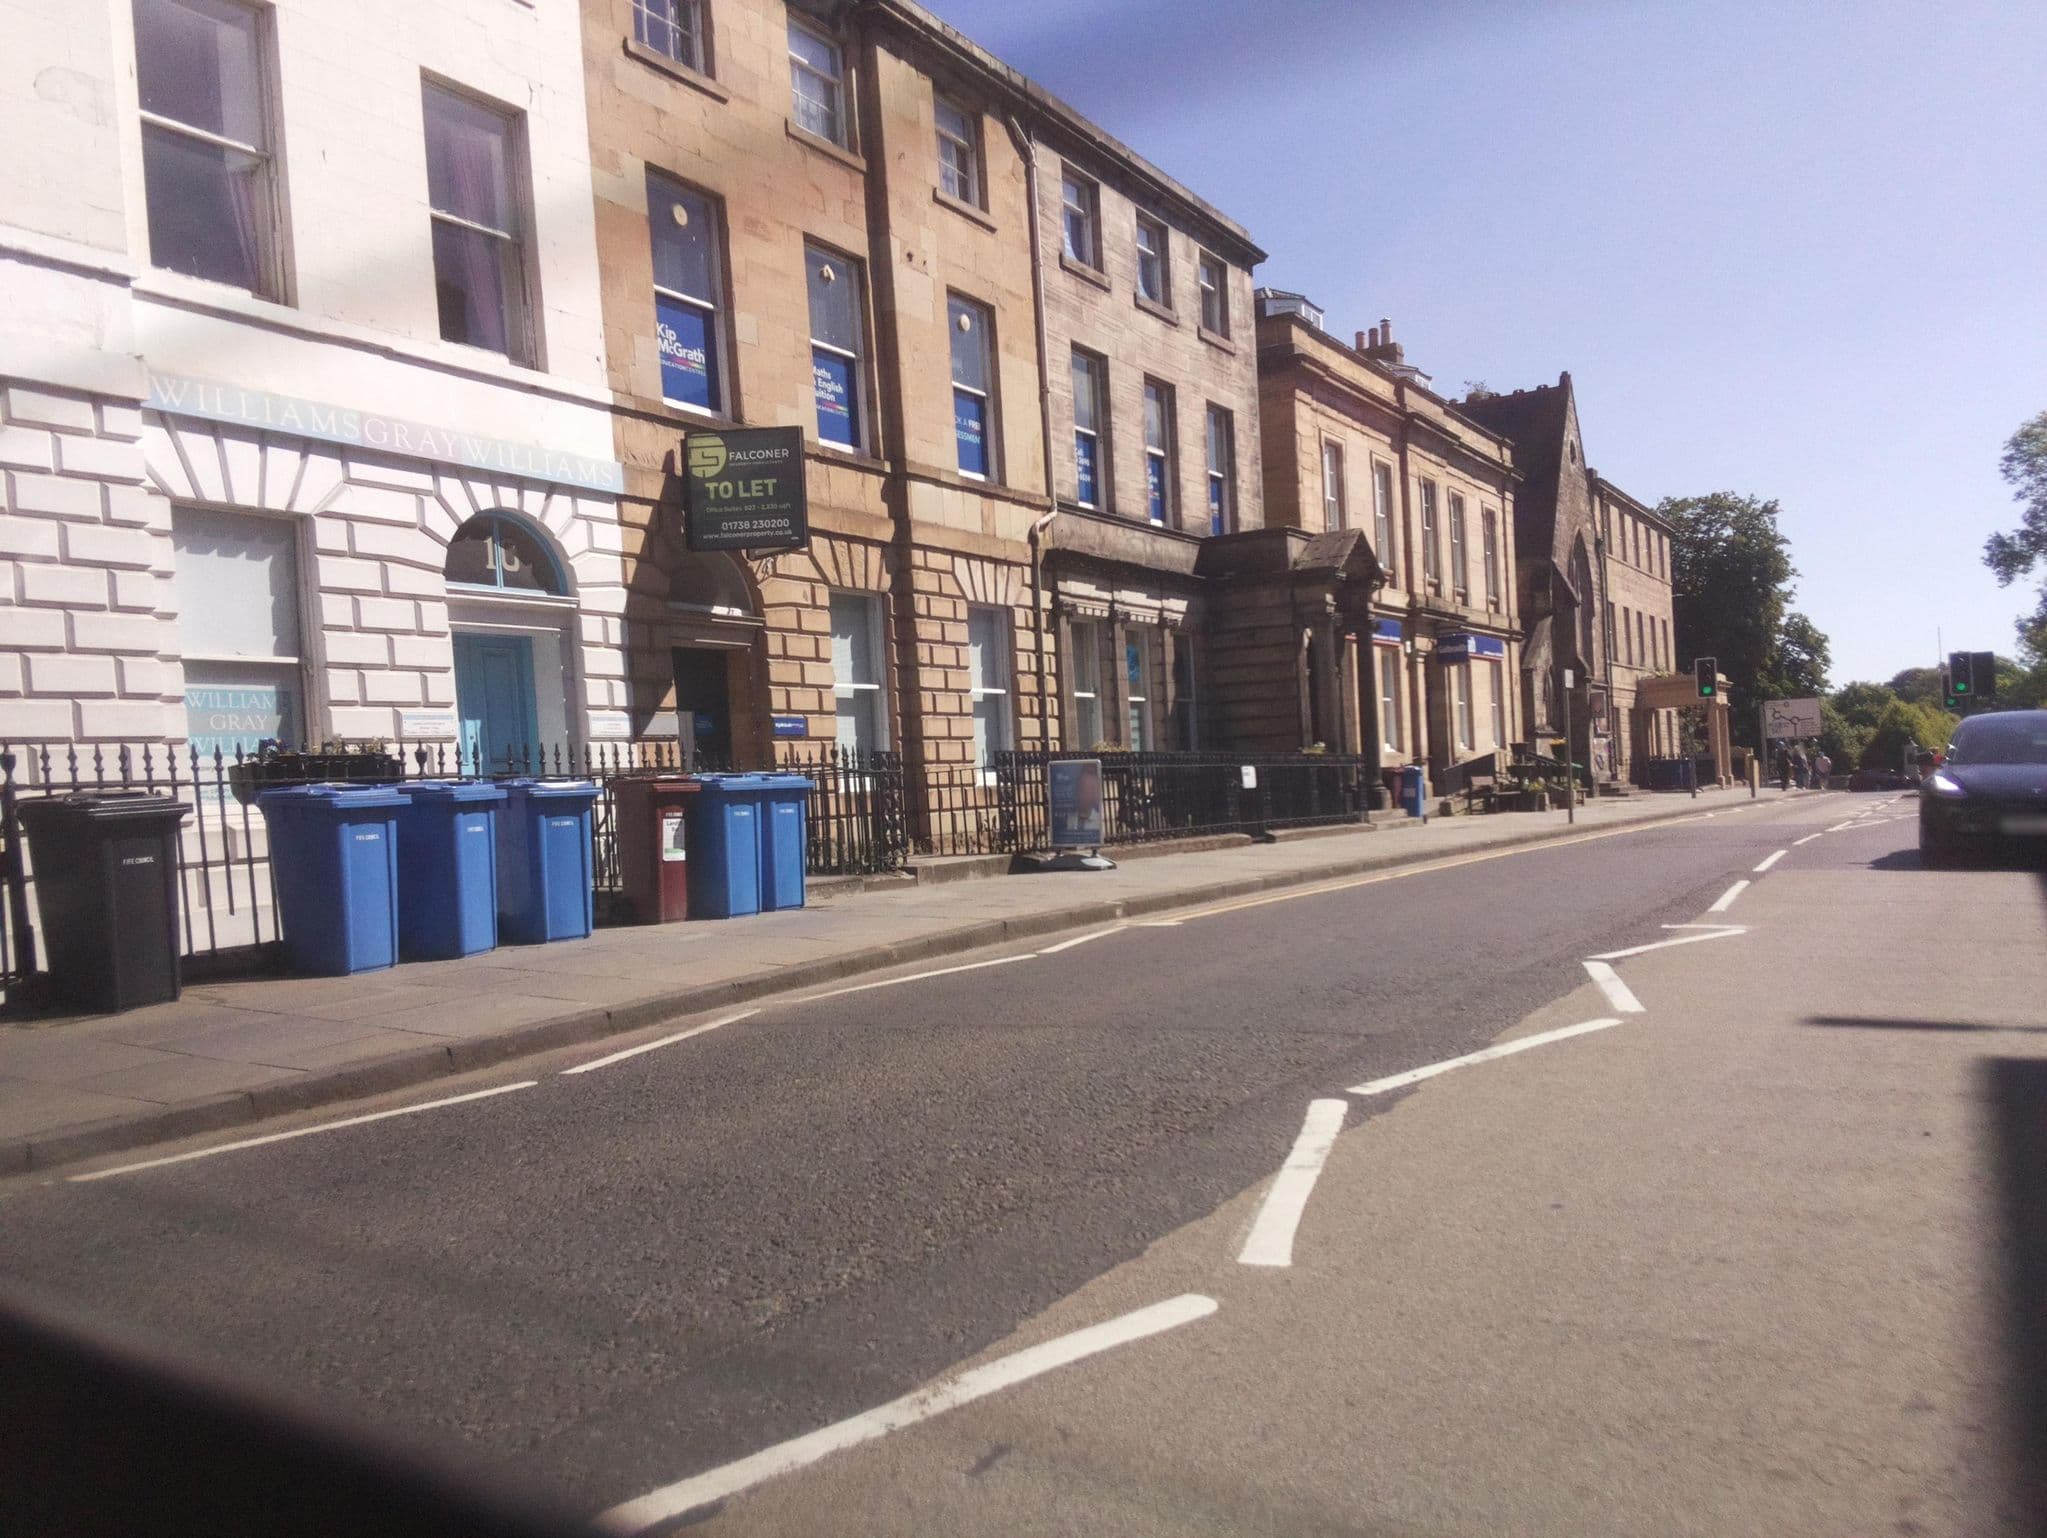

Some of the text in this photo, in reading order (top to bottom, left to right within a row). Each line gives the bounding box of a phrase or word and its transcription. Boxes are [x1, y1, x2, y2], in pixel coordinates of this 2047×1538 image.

[656, 321, 676, 345] Kip
[657, 336, 705, 364] McGrath
[815, 388, 836, 402] uition
[150, 375, 613, 487] WILLIAMS GRAY WILLIAMS
[729, 448, 790, 462] FALCONER
[705, 479, 777, 500] TO LET
[722, 518, 790, 530] 01738 230200
[186, 691, 277, 710] WILLIAM
[210, 713, 268, 731] GRAY
